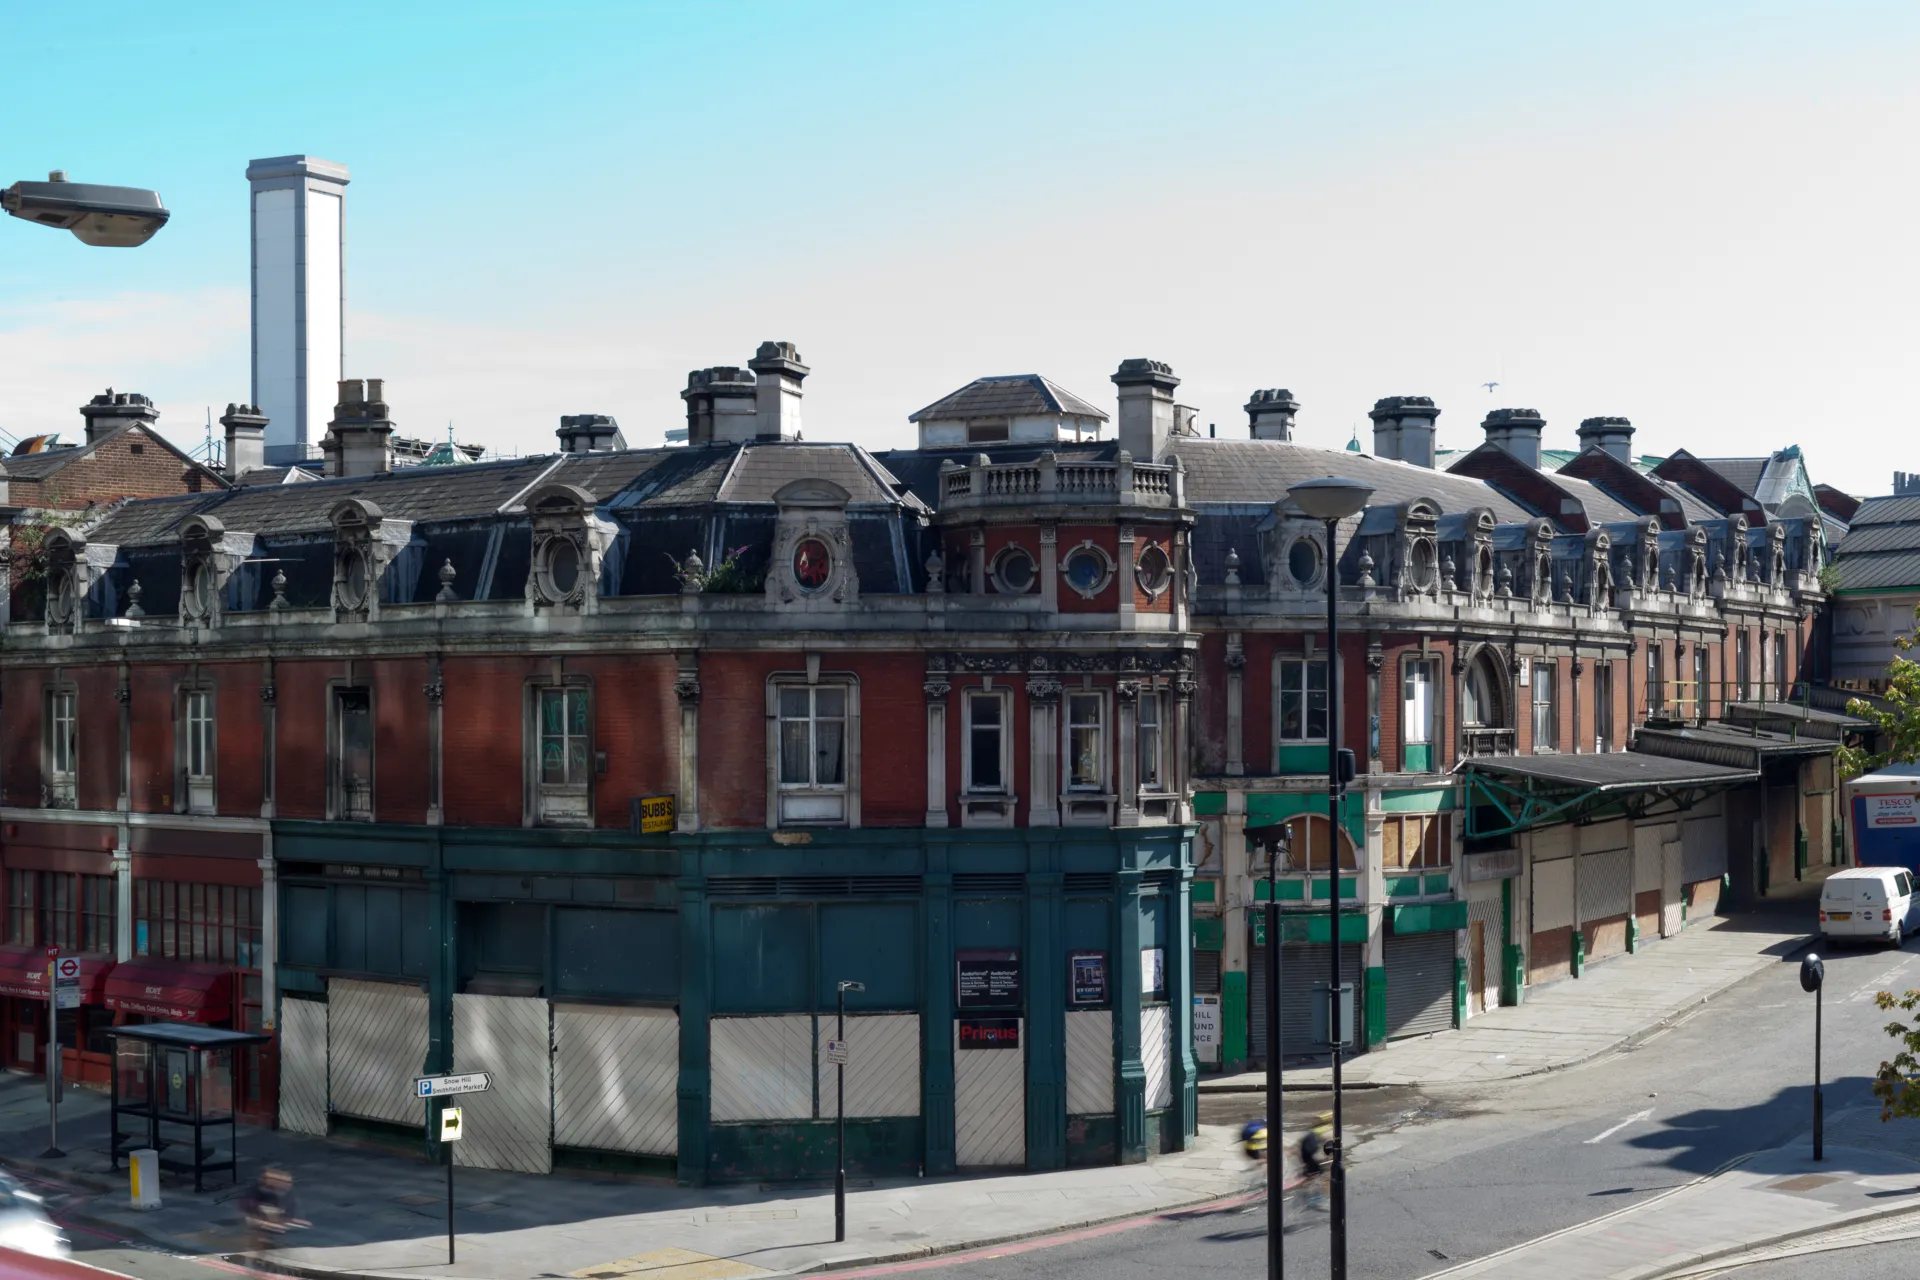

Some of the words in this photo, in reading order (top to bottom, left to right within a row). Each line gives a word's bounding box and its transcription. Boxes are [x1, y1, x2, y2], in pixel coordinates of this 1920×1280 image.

[1878, 798, 1912, 806] TESCO
[642, 800, 673, 819] BUBB'S
[48, 948, 58, 956] HT
[961, 1025, 1018, 1040] Primus
[432, 1086, 461, 1094] Smithfield
